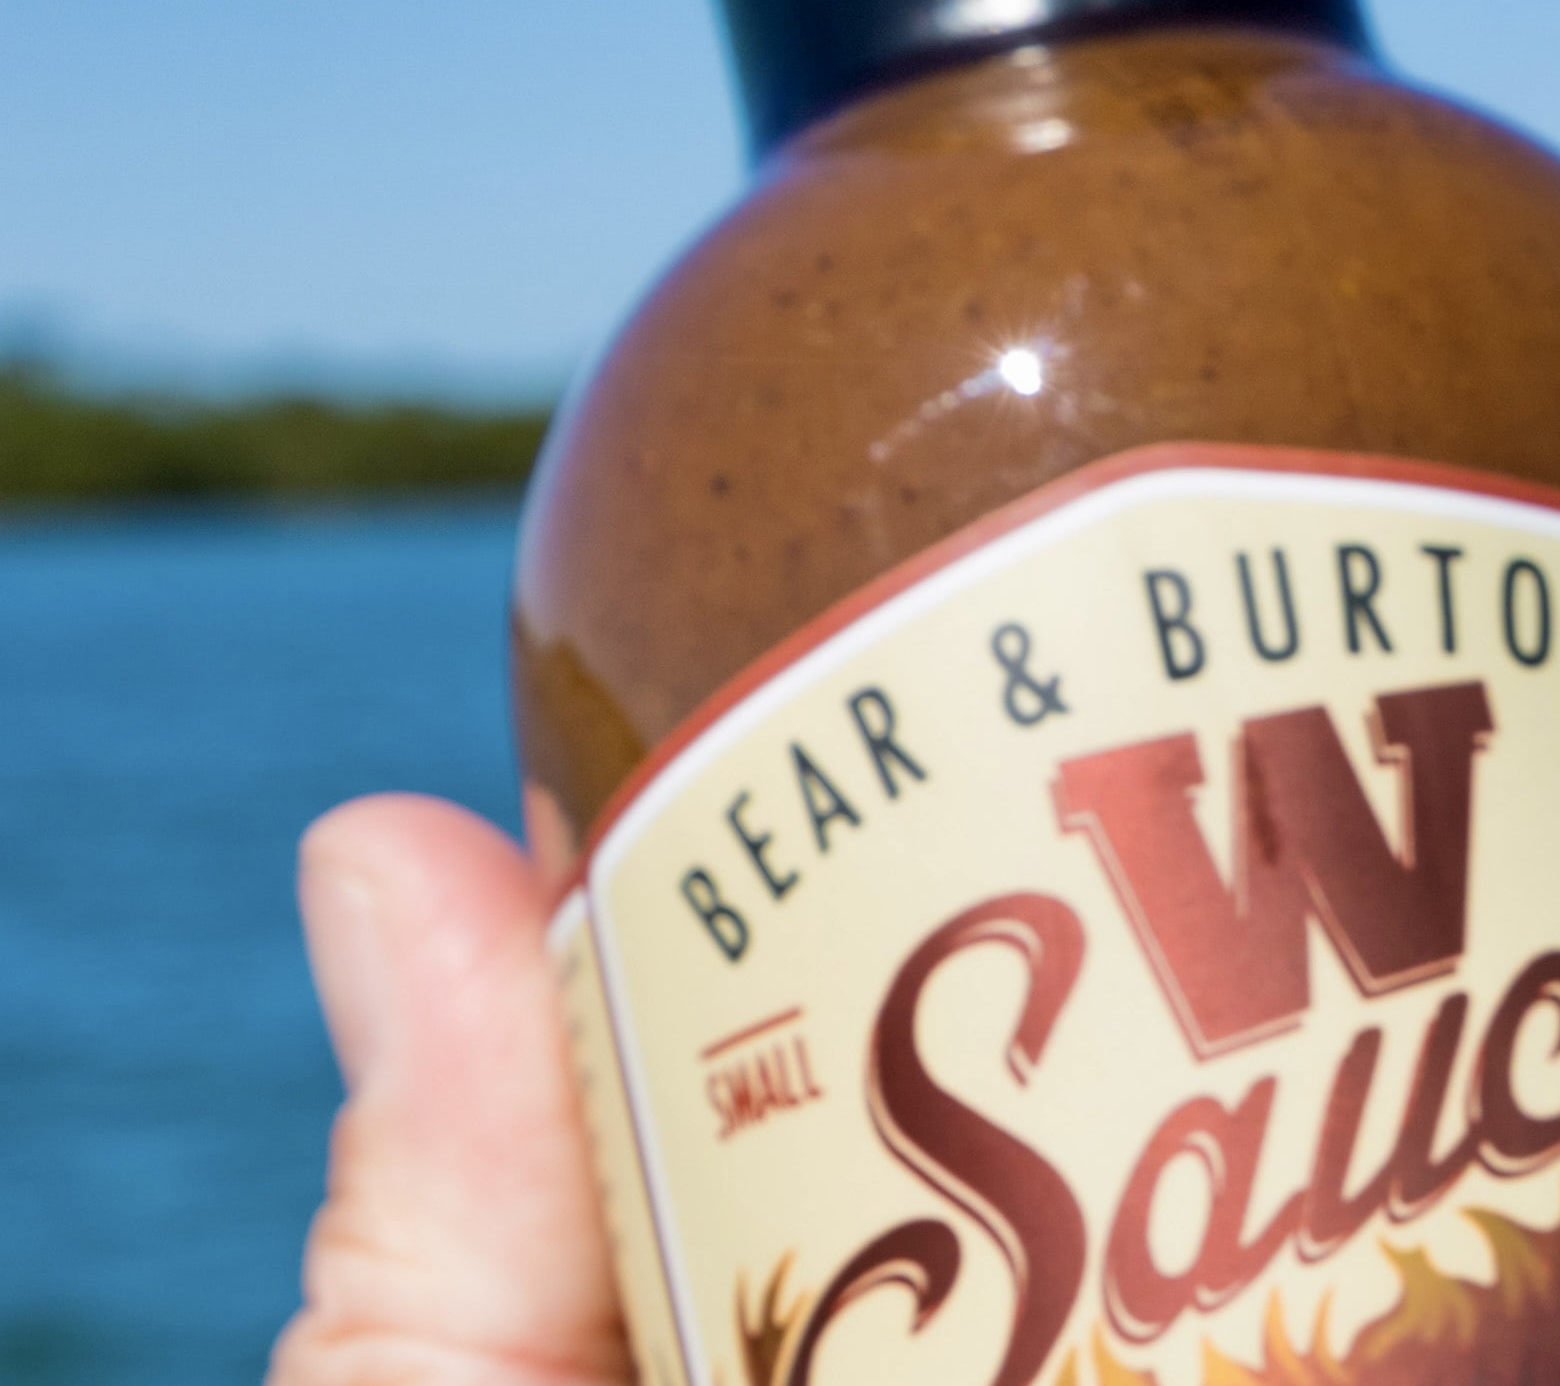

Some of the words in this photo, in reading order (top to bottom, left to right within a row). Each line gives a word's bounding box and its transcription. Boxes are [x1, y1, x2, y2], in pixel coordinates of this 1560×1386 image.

[679, 683, 929, 965] BEAR
[990, 622, 1072, 727] &
[1049, 678, 1497, 1064] W
[705, 1035, 824, 1141] SMALL
